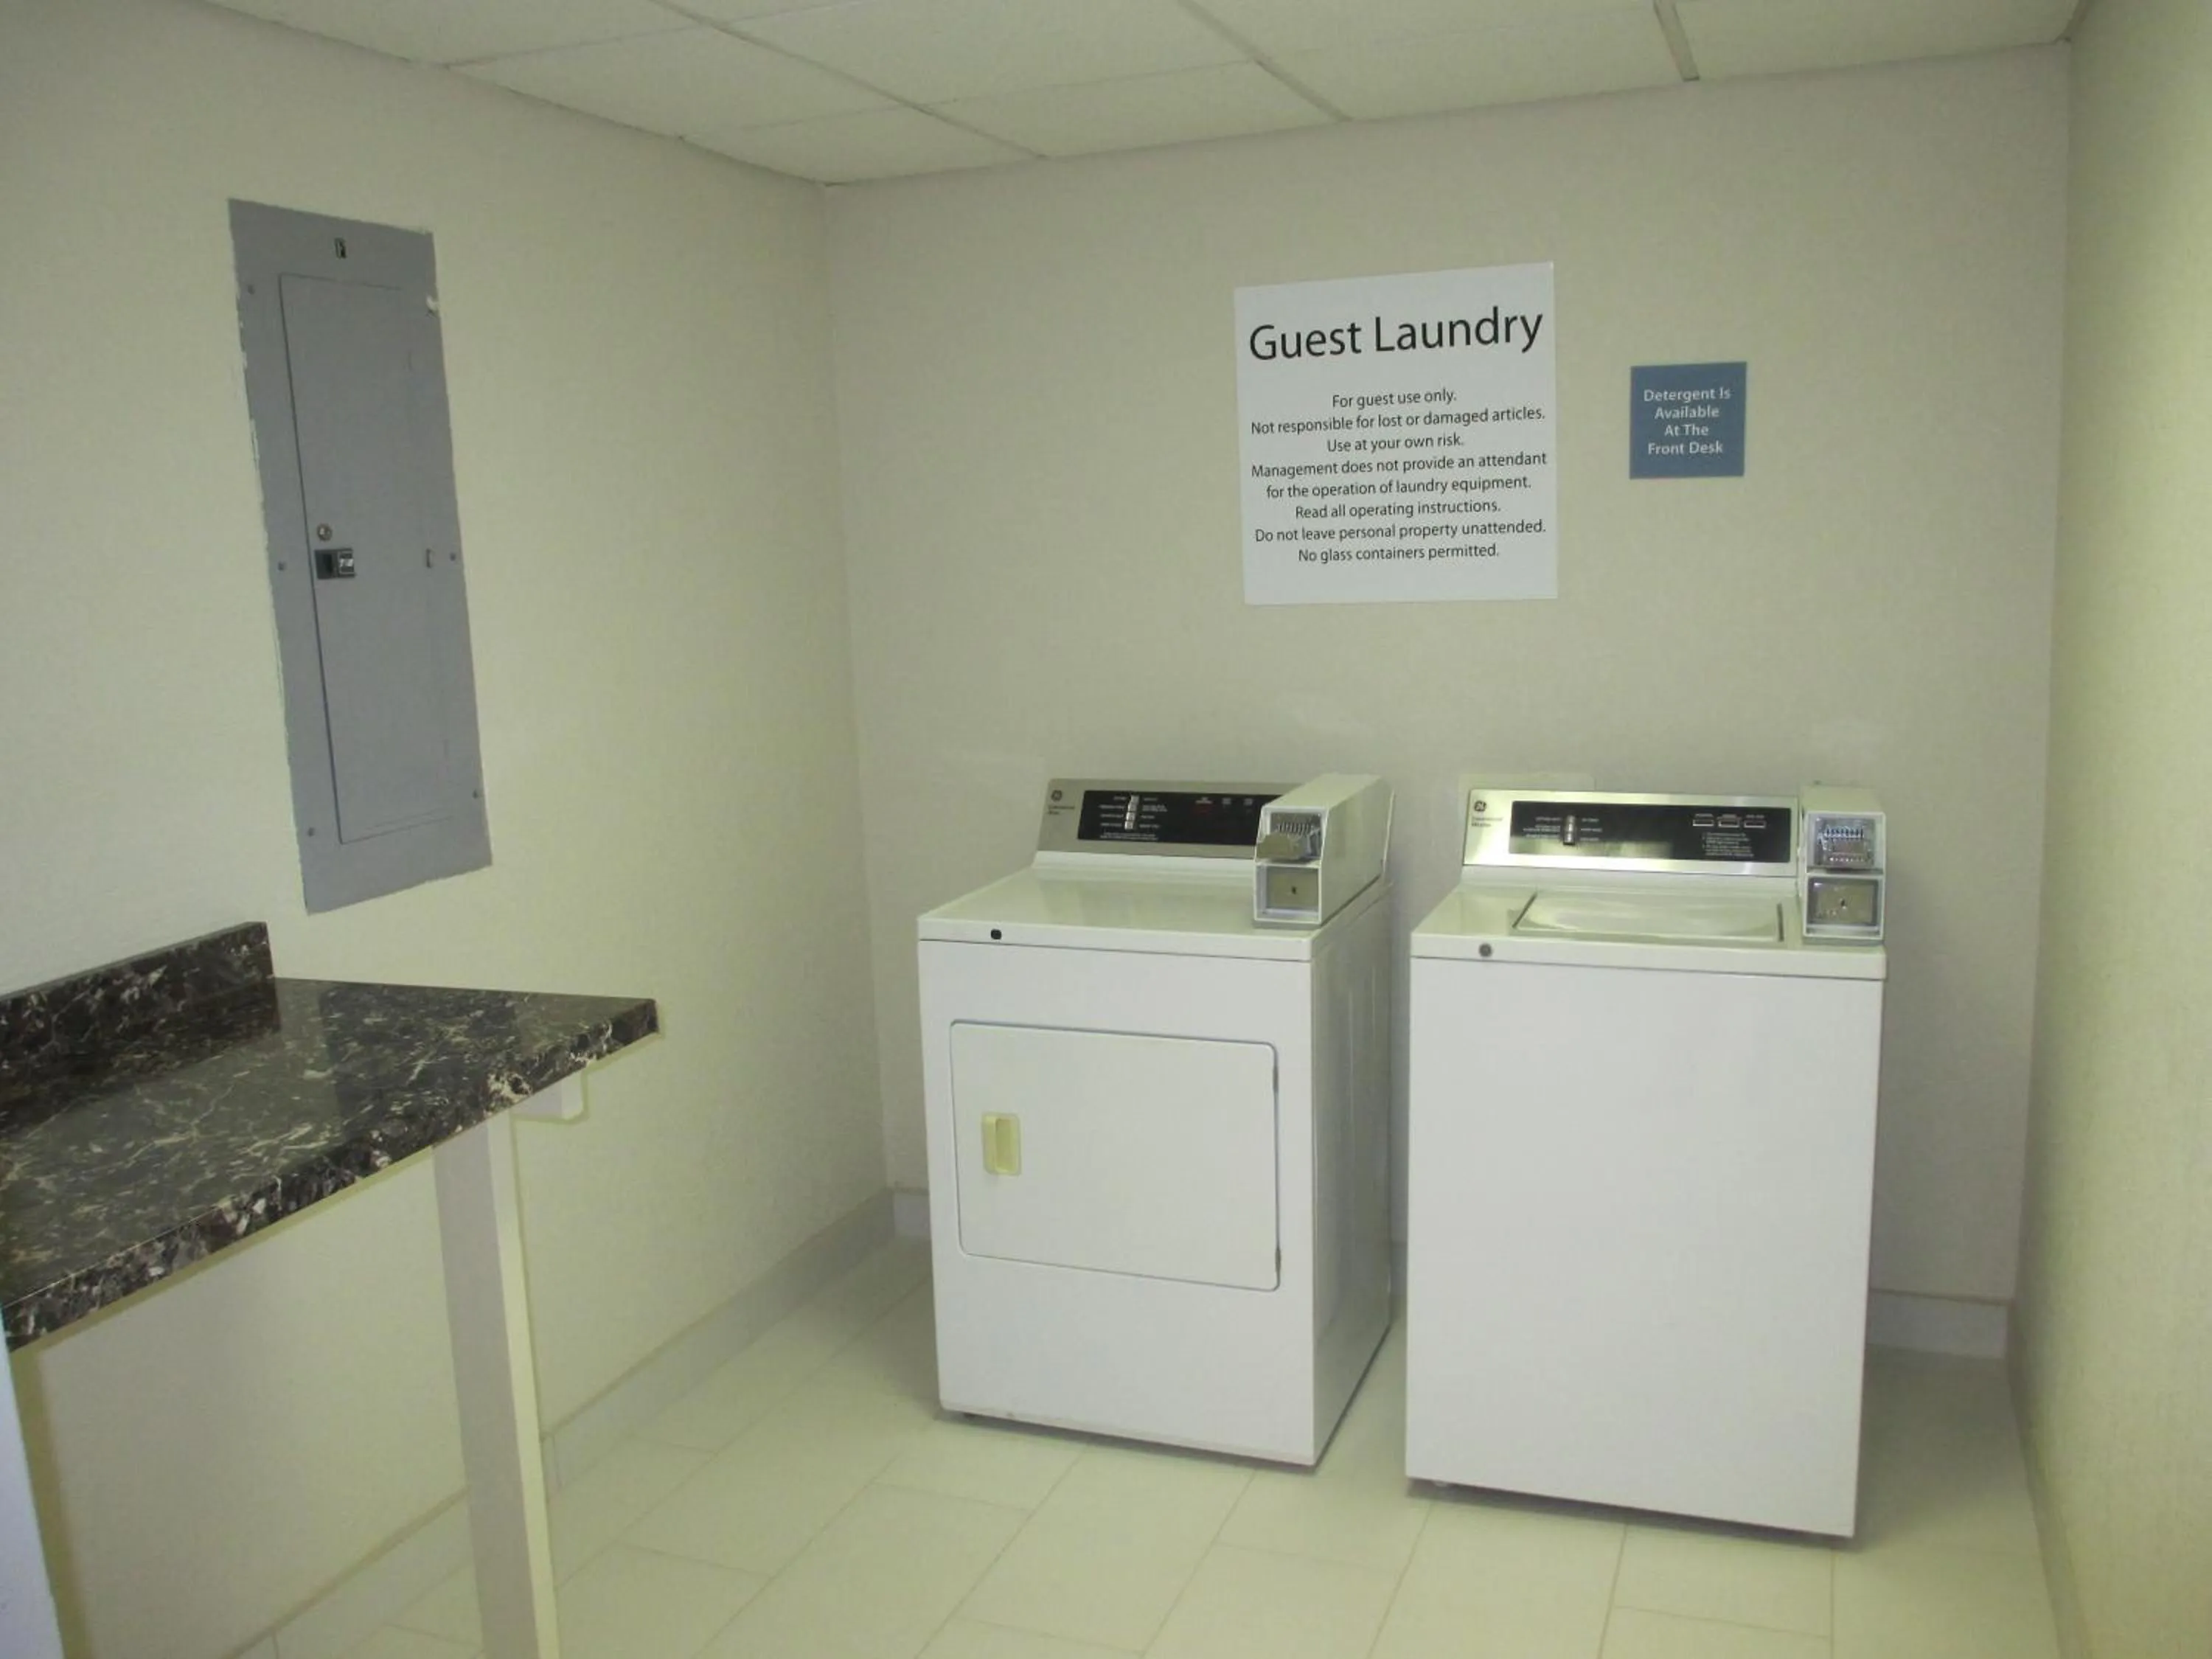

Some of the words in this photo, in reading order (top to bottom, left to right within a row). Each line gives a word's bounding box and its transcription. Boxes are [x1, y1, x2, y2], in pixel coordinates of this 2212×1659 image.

[1249, 321, 1362, 361] Guest
[1375, 305, 1543, 353] Laundry
[1332, 394, 1354, 408] For
[1356, 393, 1395, 411] guest
[1397, 392, 1422, 405] use
[1423, 386, 1457, 406] only.
[1644, 389, 1717, 404] Detergent
[1719, 386, 1731, 400] Is
[1251, 421, 1275, 435] Not
[1277, 416, 1354, 436] responsible
[1355, 414, 1376, 429] for
[1377, 413, 1403, 428] lost
[1405, 414, 1421, 427] or
[1422, 407, 1489, 427] damaged
[1492, 405, 1545, 422] articles.
[1654, 404, 1719, 420] Available
[1664, 424, 1680, 437] At
[1683, 422, 1709, 437] The
[1326, 438, 1352, 453] Use
[1354, 439, 1368, 451] at
[1370, 439, 1402, 455] your
[1404, 437, 1434, 449] own
[1437, 431, 1464, 448] risk.
[1647, 442, 1685, 455] Front
[1688, 439, 1723, 454] Desk
[1251, 462, 1338, 480] Management
[1340, 459, 1374, 474] does
[1376, 459, 1399, 473] not
[1402, 454, 1455, 474] provide
[1458, 457, 1475, 469] an
[1478, 451, 1547, 467] attendant
[1266, 484, 1285, 499] for
[1287, 483, 1310, 498] the
[1312, 481, 1377, 500] operation
[1378, 479, 1394, 494] of
[1396, 477, 1449, 495] laundry
[1450, 476, 1531, 494] equipment.
[1295, 504, 1329, 520] Read
[1330, 503, 1346, 518] all
[1349, 501, 1414, 521] operating
[1417, 498, 1501, 515] instructions.
[1254, 528, 1274, 543] Do
[1276, 529, 1299, 542] not
[1301, 526, 1336, 541] leave
[1338, 523, 1397, 543] personal
[1399, 524, 1458, 540] property
[1461, 518, 1546, 535] unattended.
[1298, 549, 1318, 563] No
[1320, 548, 1353, 565] glass
[1354, 546, 1425, 561] containers
[1428, 542, 1499, 561] permitted.
